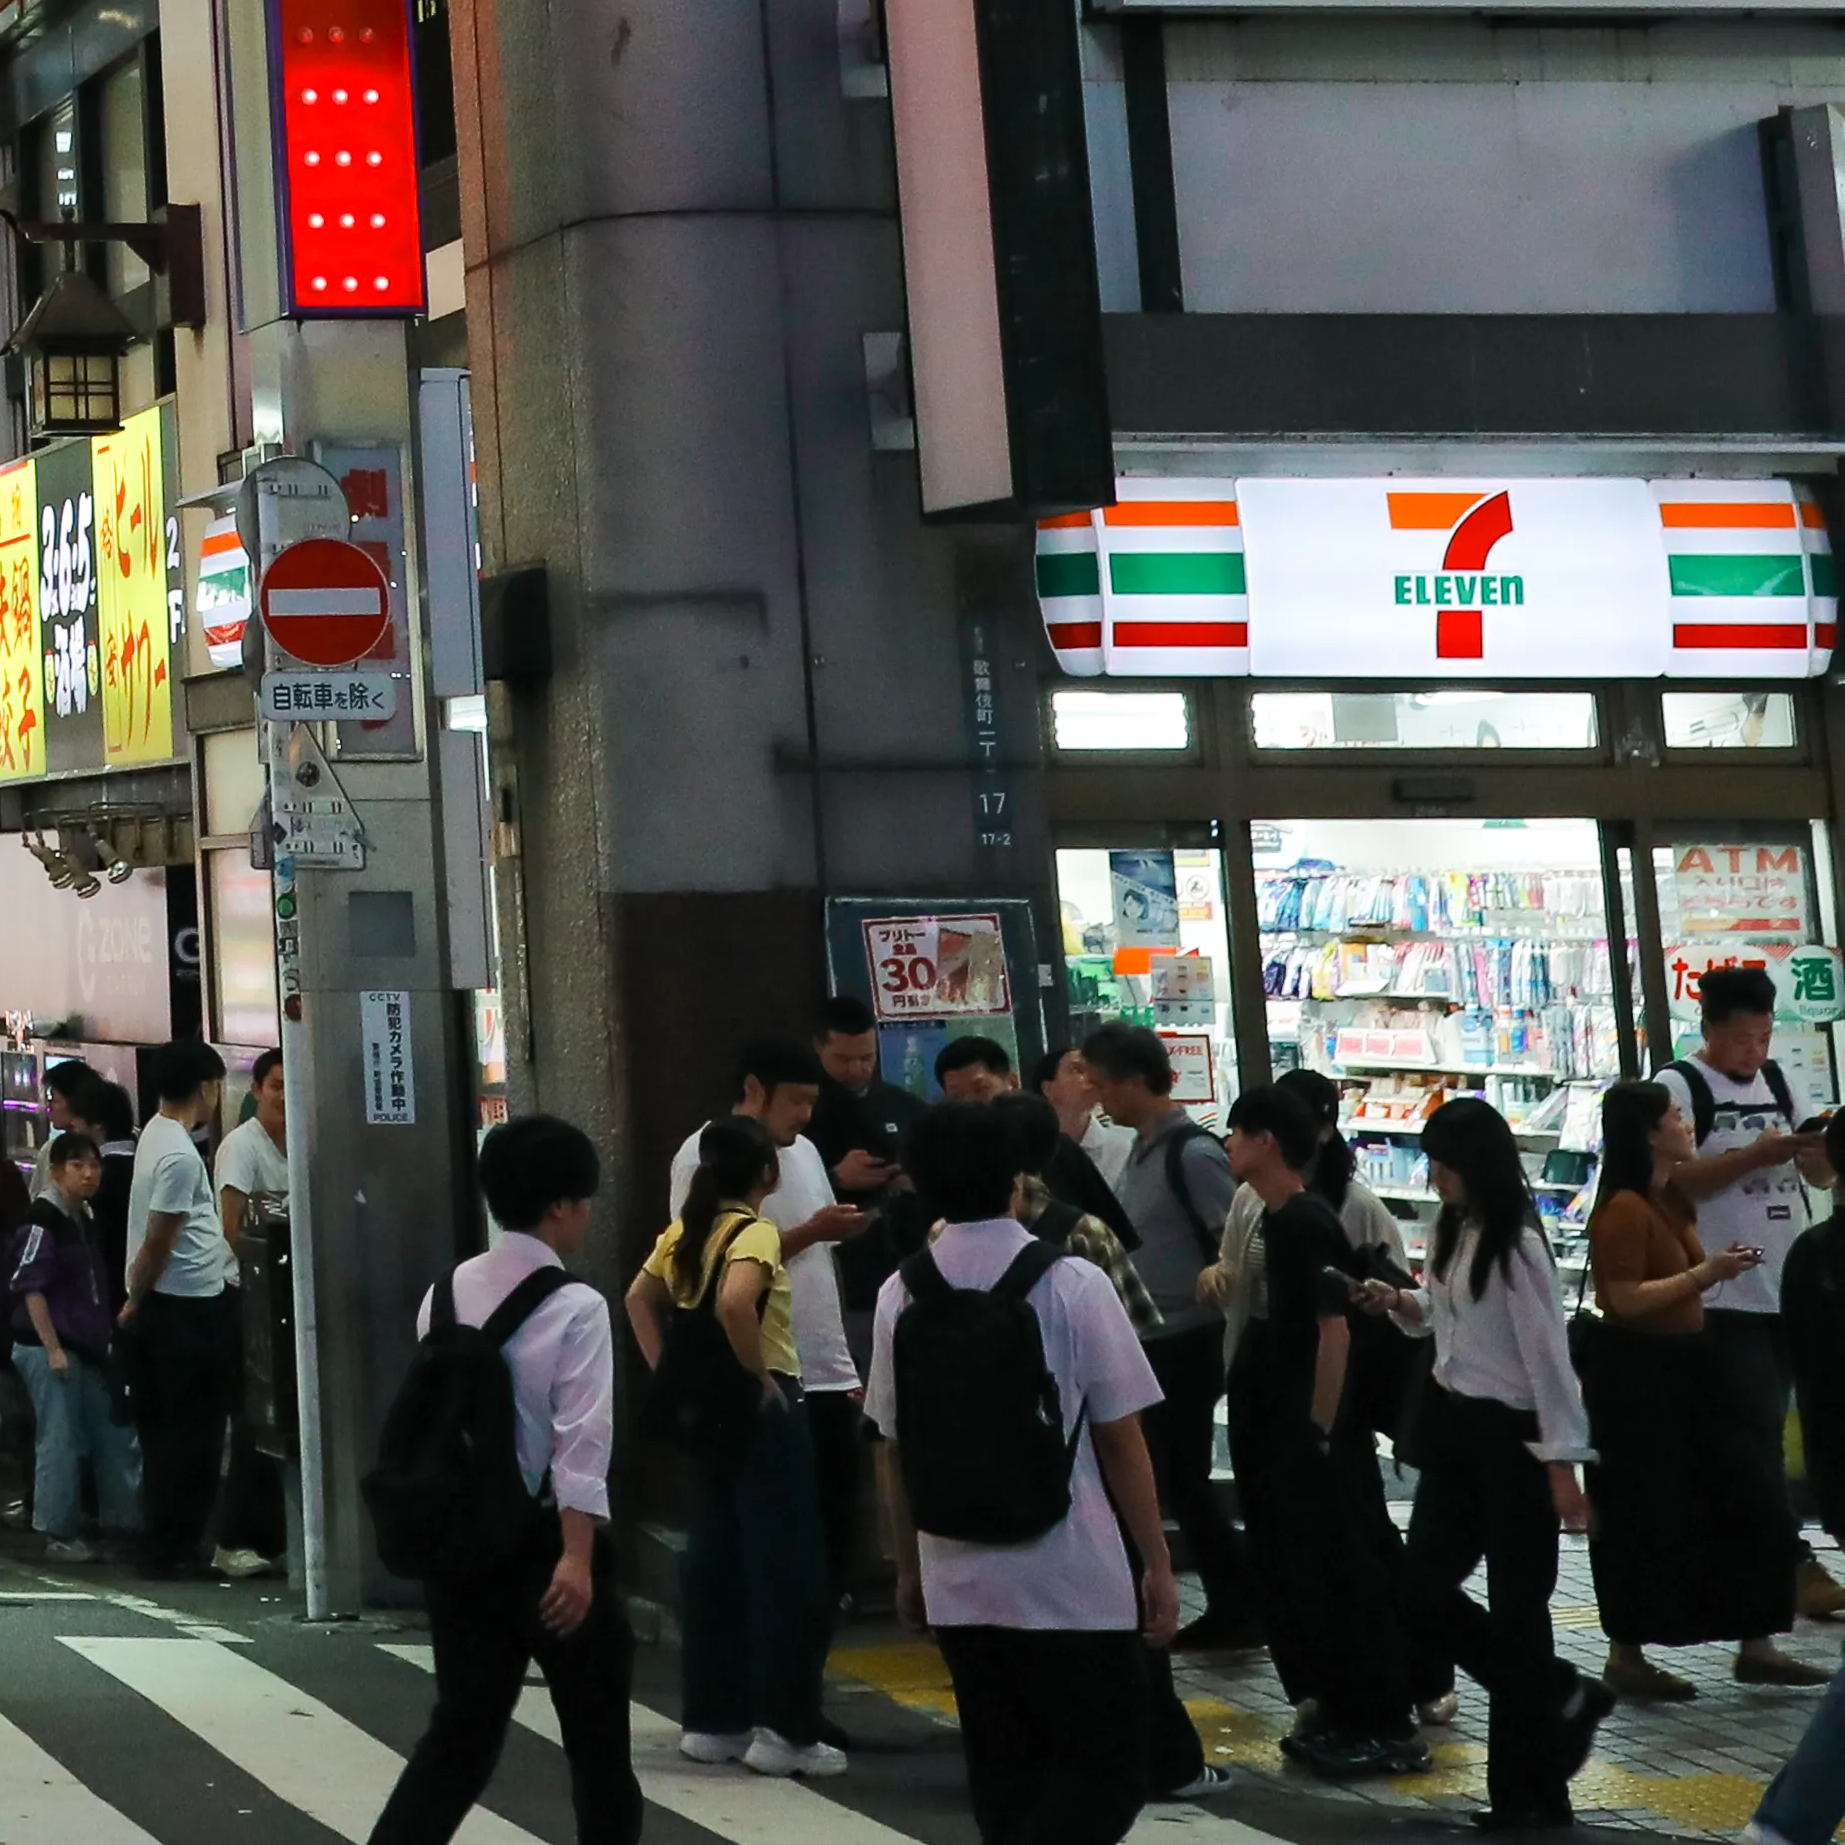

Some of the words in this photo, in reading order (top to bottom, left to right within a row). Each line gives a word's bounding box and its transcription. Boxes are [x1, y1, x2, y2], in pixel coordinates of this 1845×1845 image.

[271, 681, 386, 712] 自転車を除く
[978, 792, 1006, 815] 17
[1677, 846, 1799, 874] ATM
[880, 956, 938, 993] 30
[1790, 956, 1836, 1001] 酒
[368, 992, 402, 1002] CCTV
[385, 1002, 407, 1112] 防犯カメラ作動中
[372, 1112, 410, 1123] POLICE
